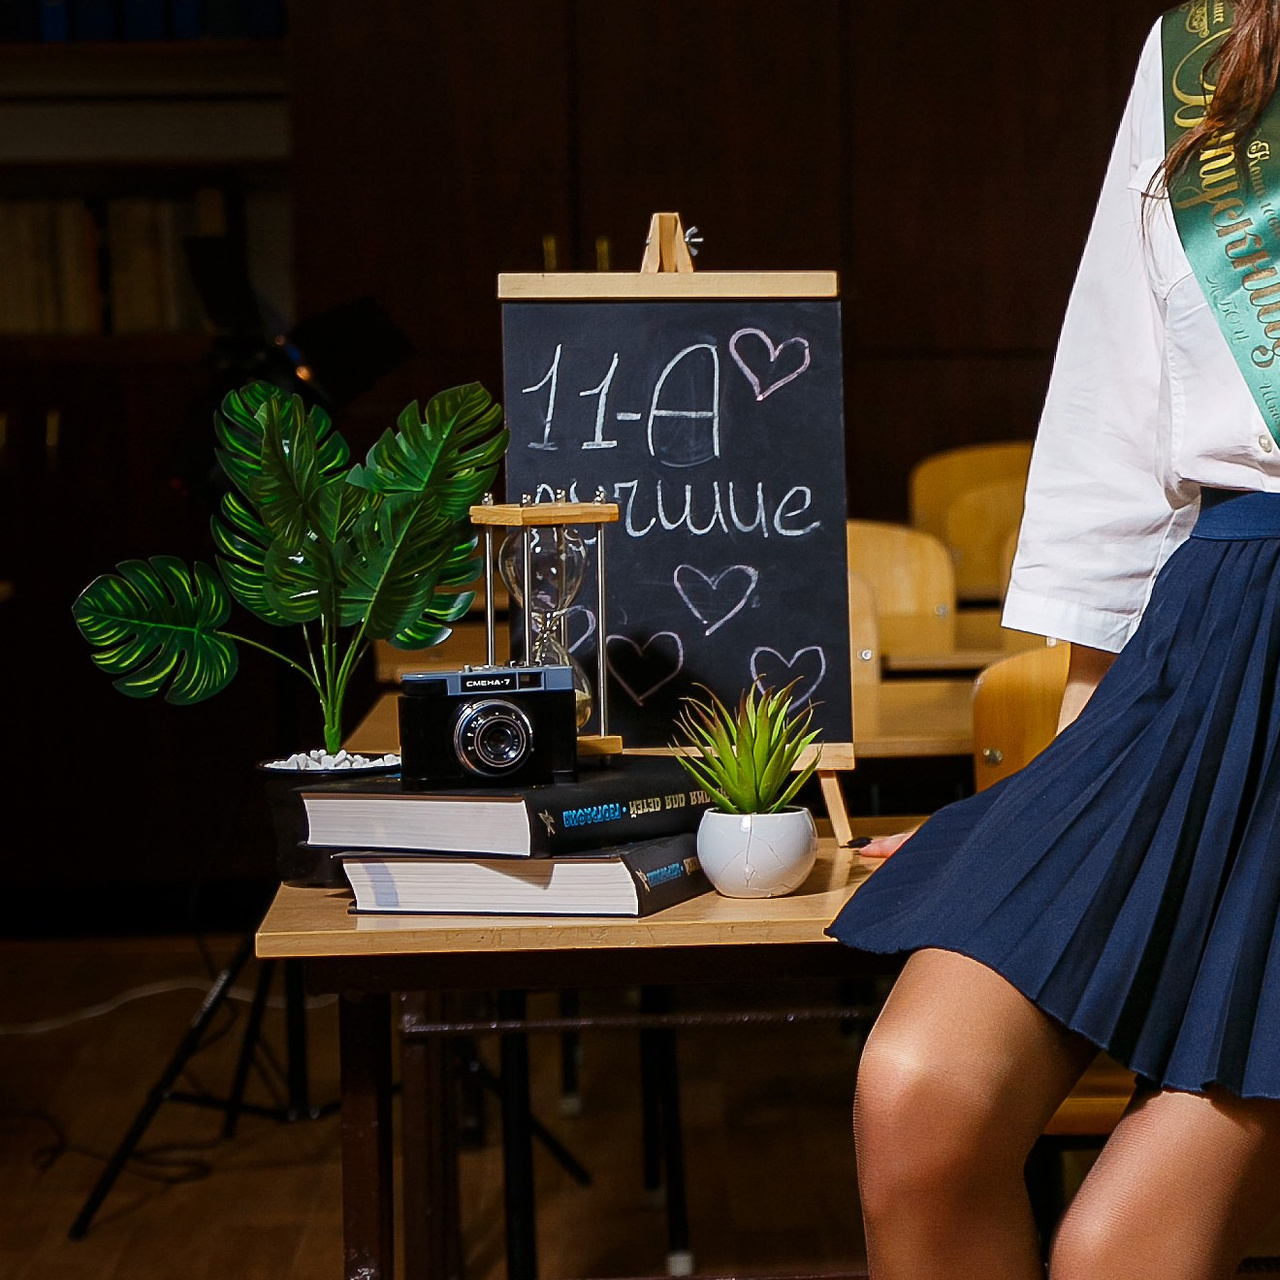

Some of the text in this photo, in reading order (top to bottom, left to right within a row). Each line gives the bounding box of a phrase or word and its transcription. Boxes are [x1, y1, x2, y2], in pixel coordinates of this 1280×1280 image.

[522, 343, 720, 458] 11-А
[629, 797, 662, 818] ДЕТЕЙ
[665, 793, 686, 810] ДЛЯ
[562, 803, 621, 828] ГЕОГРАФИЯ
